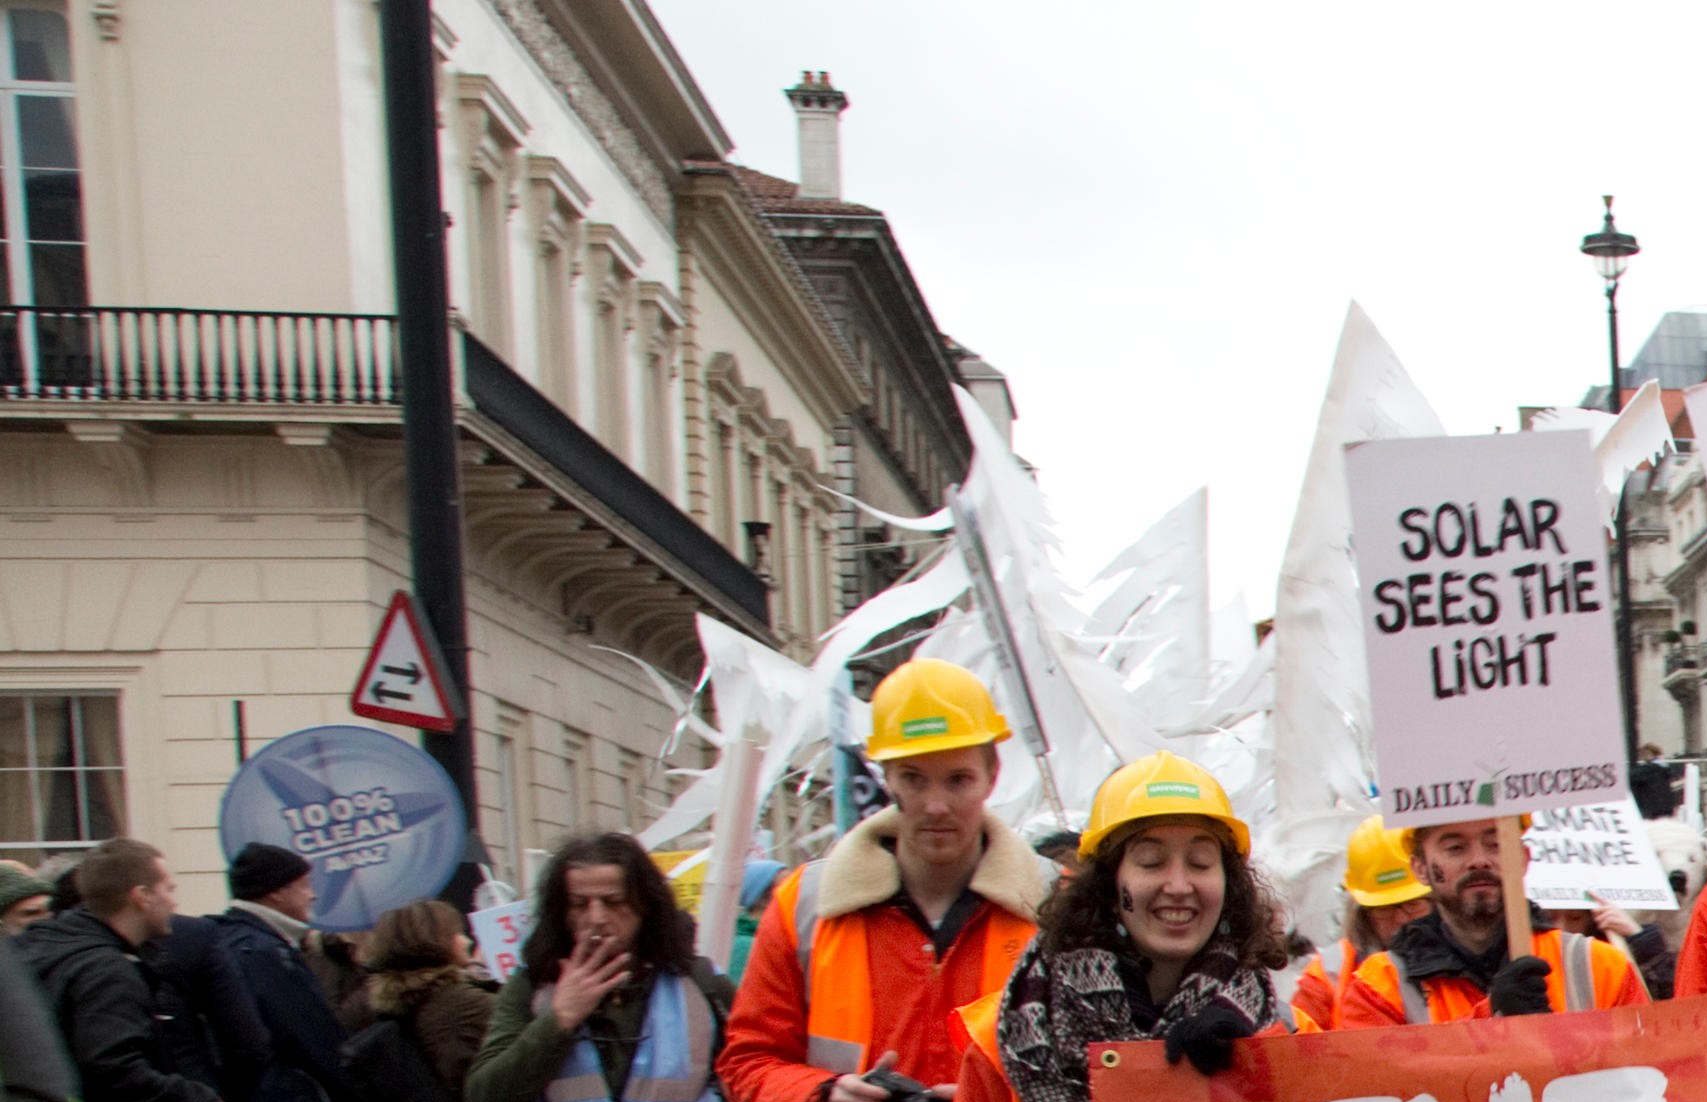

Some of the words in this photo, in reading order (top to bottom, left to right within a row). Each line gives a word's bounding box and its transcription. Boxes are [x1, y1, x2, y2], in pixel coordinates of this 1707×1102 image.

[1399, 497, 1568, 562] SOLAR
[1374, 571, 1500, 634] SEES
[1512, 560, 1601, 620] THE
[281, 786, 396, 832] 100%
[1393, 778, 1475, 814] DAILY
[1504, 763, 1616, 801] SUCCESS
[292, 813, 402, 853] CLEAN
